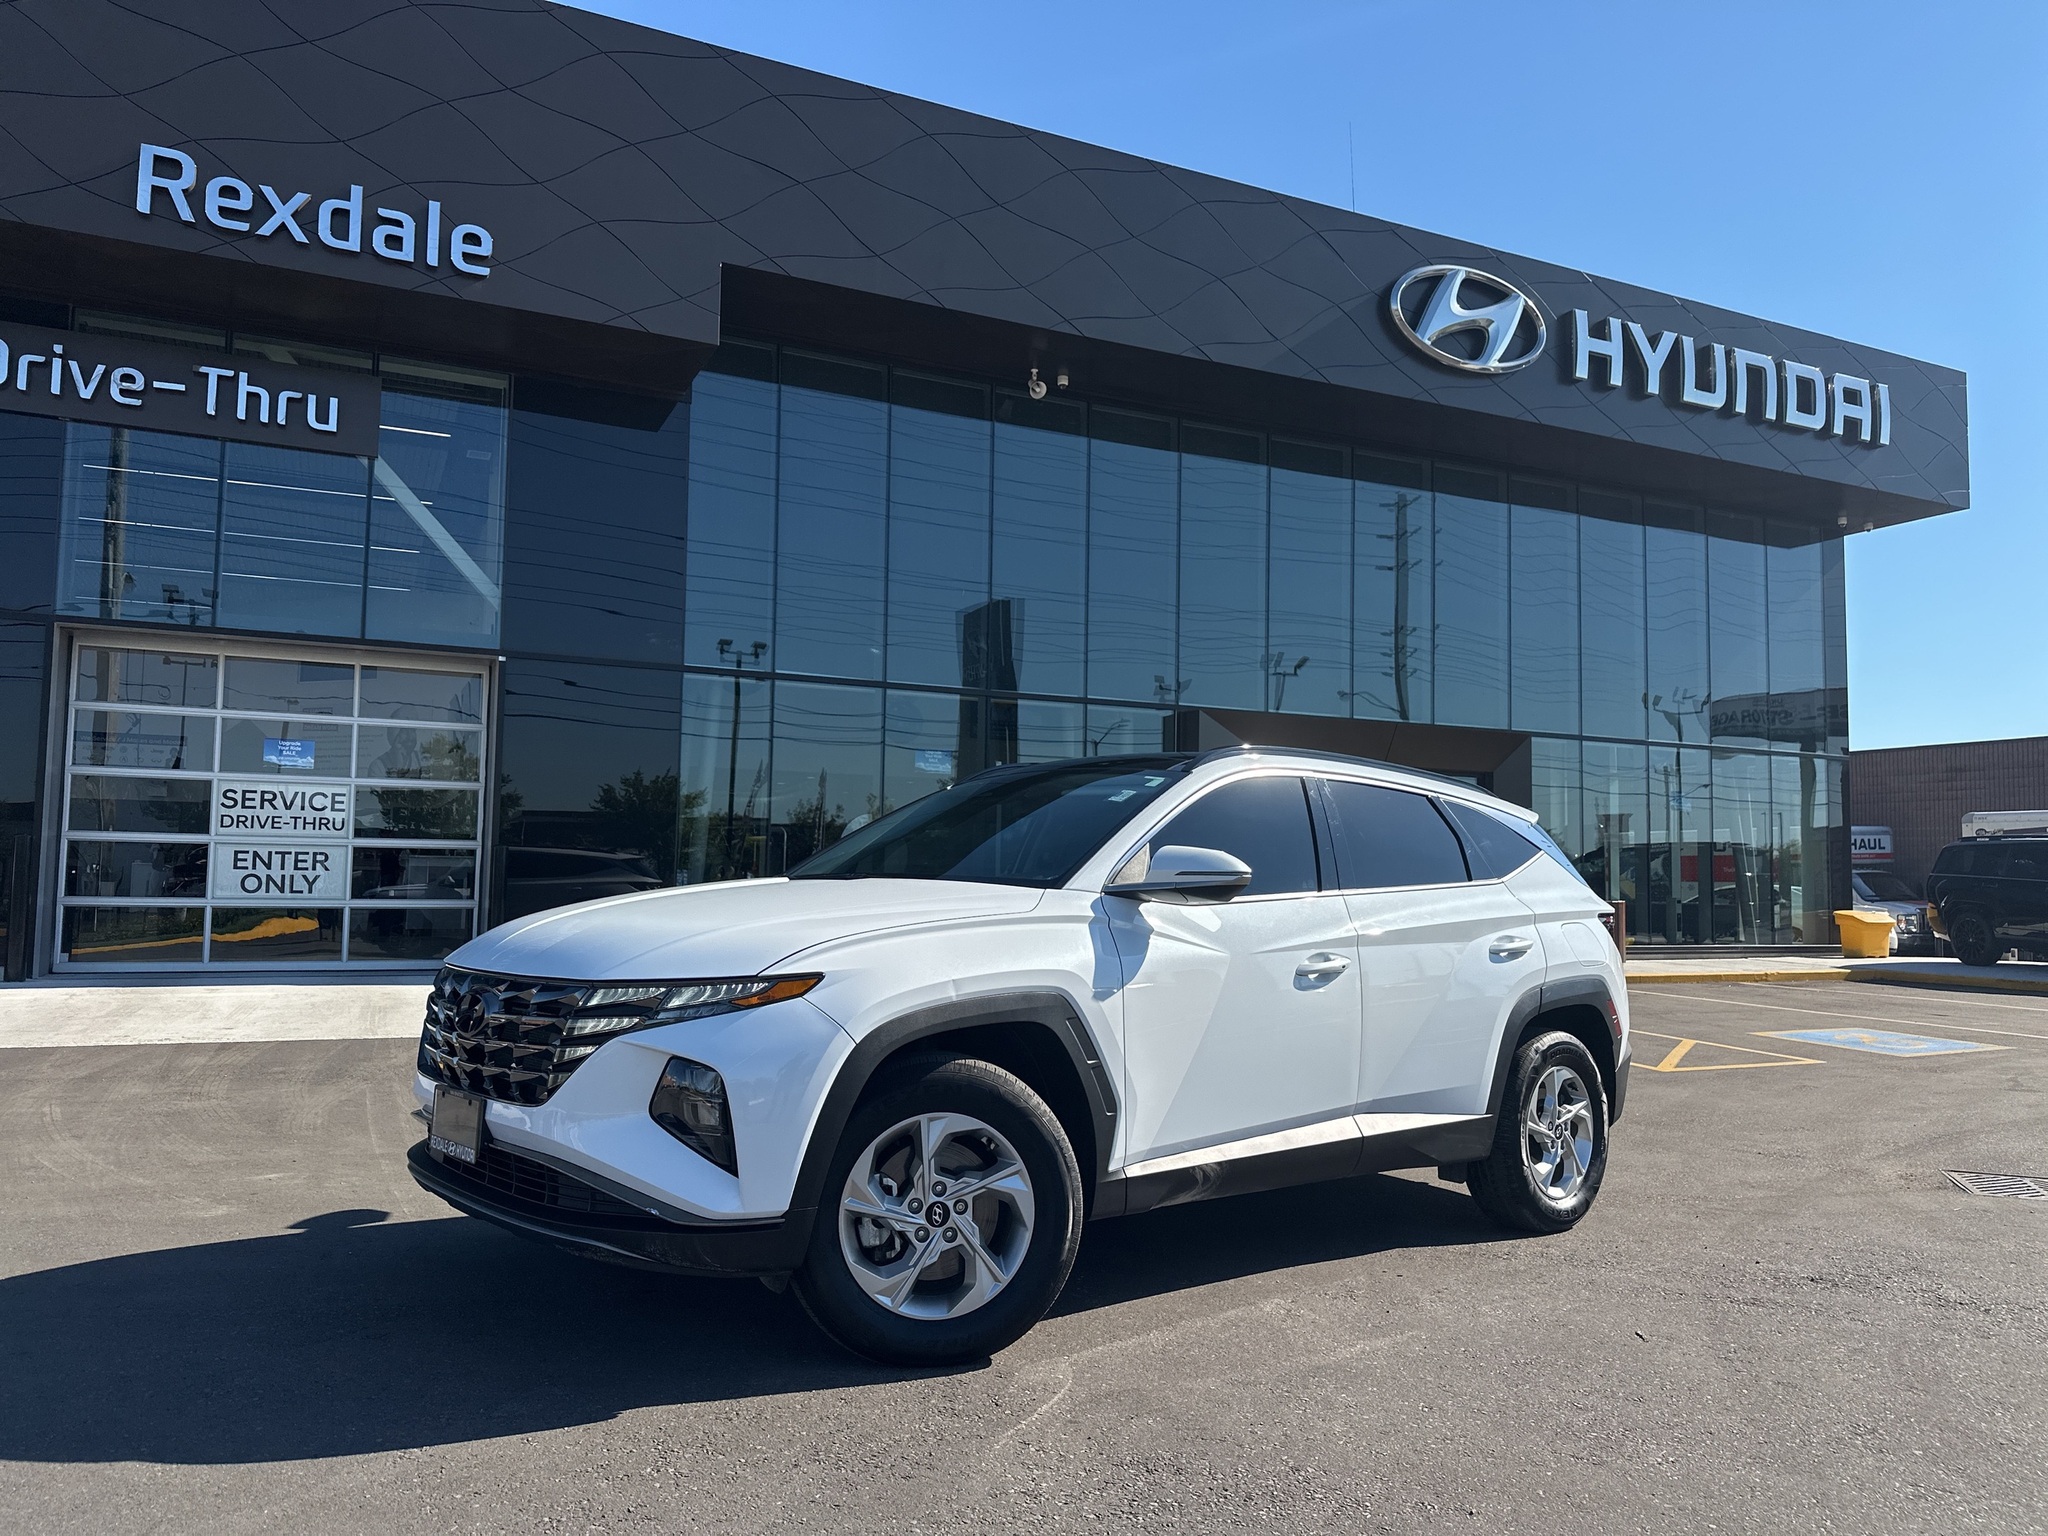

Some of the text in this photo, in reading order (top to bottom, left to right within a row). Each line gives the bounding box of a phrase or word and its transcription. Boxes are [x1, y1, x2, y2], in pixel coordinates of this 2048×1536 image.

[136, 143, 494, 276] Rexdale
[1572, 309, 1892, 446] HYUNDAI
[220, 788, 346, 812] SERVICE
[219, 814, 345, 832] DRIVE-THRU
[232, 849, 331, 872] ENTER
[240, 873, 321, 895] ONLY
